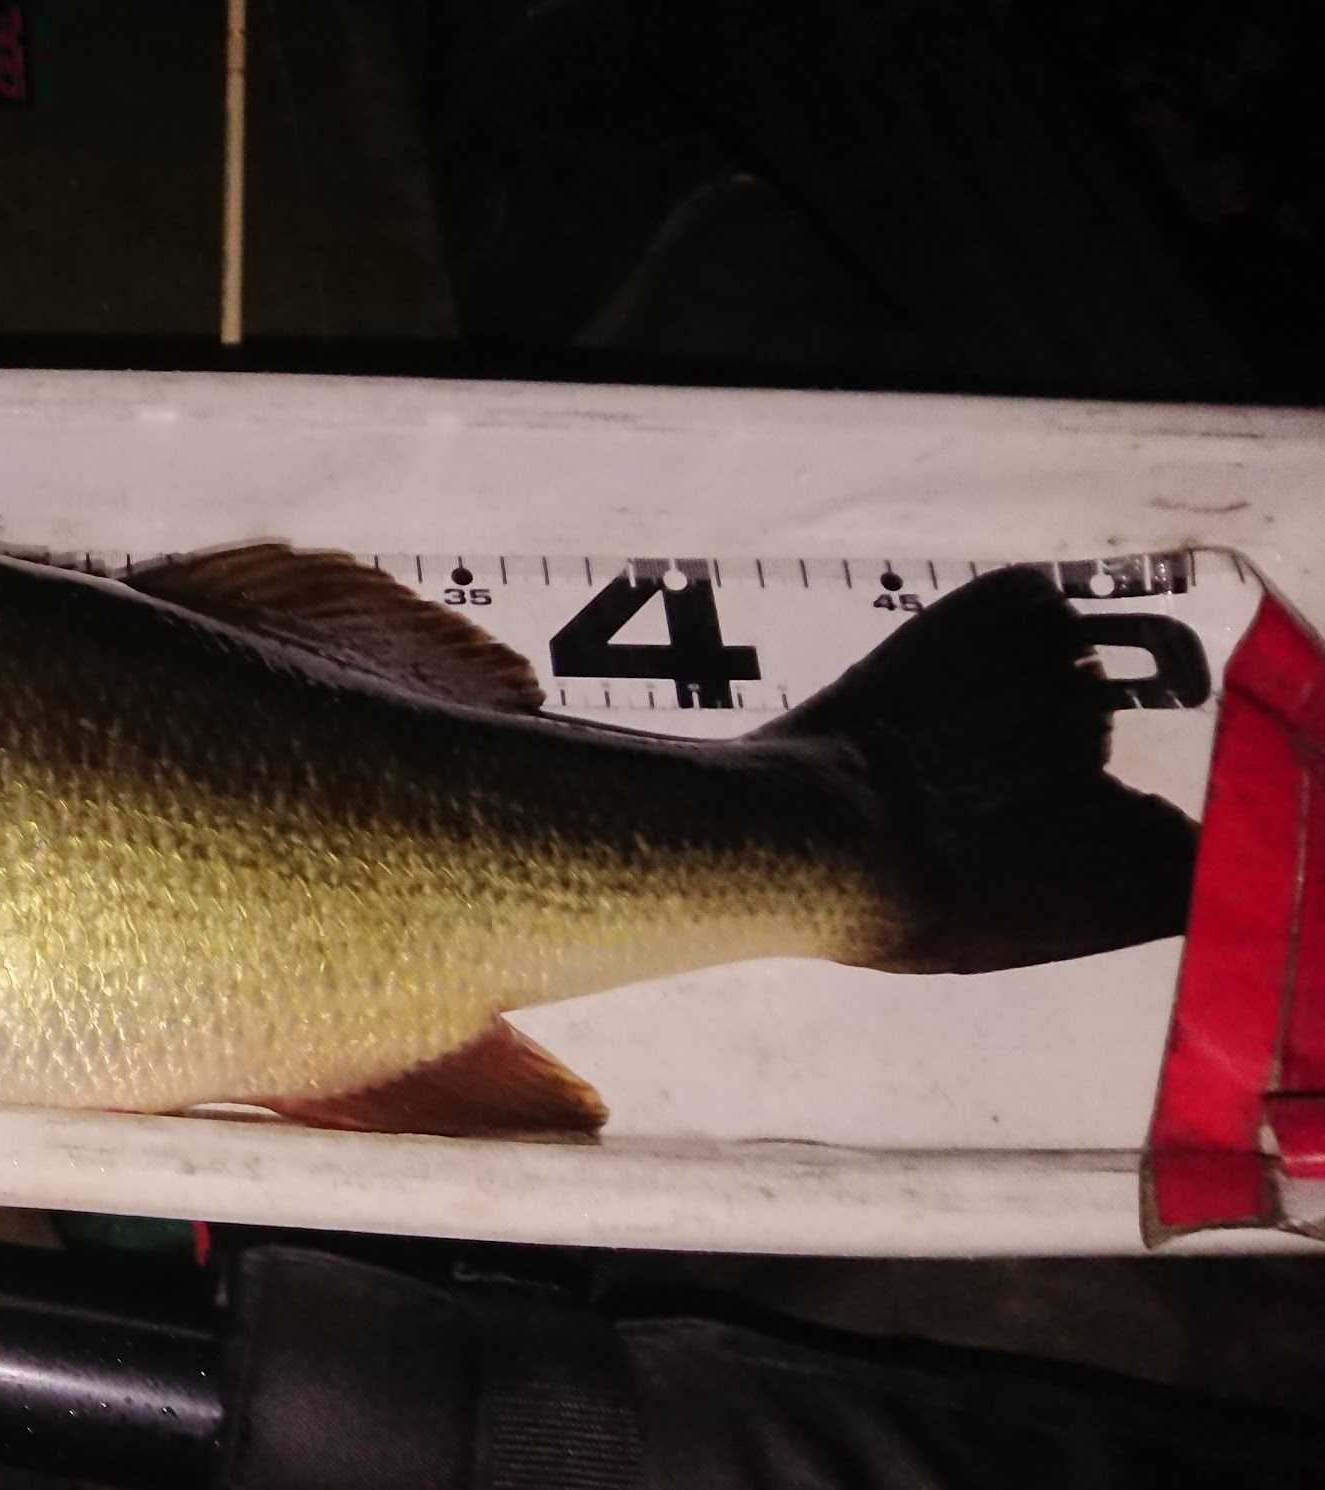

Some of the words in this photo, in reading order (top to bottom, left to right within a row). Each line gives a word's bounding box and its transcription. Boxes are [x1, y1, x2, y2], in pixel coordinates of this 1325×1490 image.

[444, 588, 492, 605] 35
[873, 594, 923, 613] 45
[550, 558, 761, 709] 4
